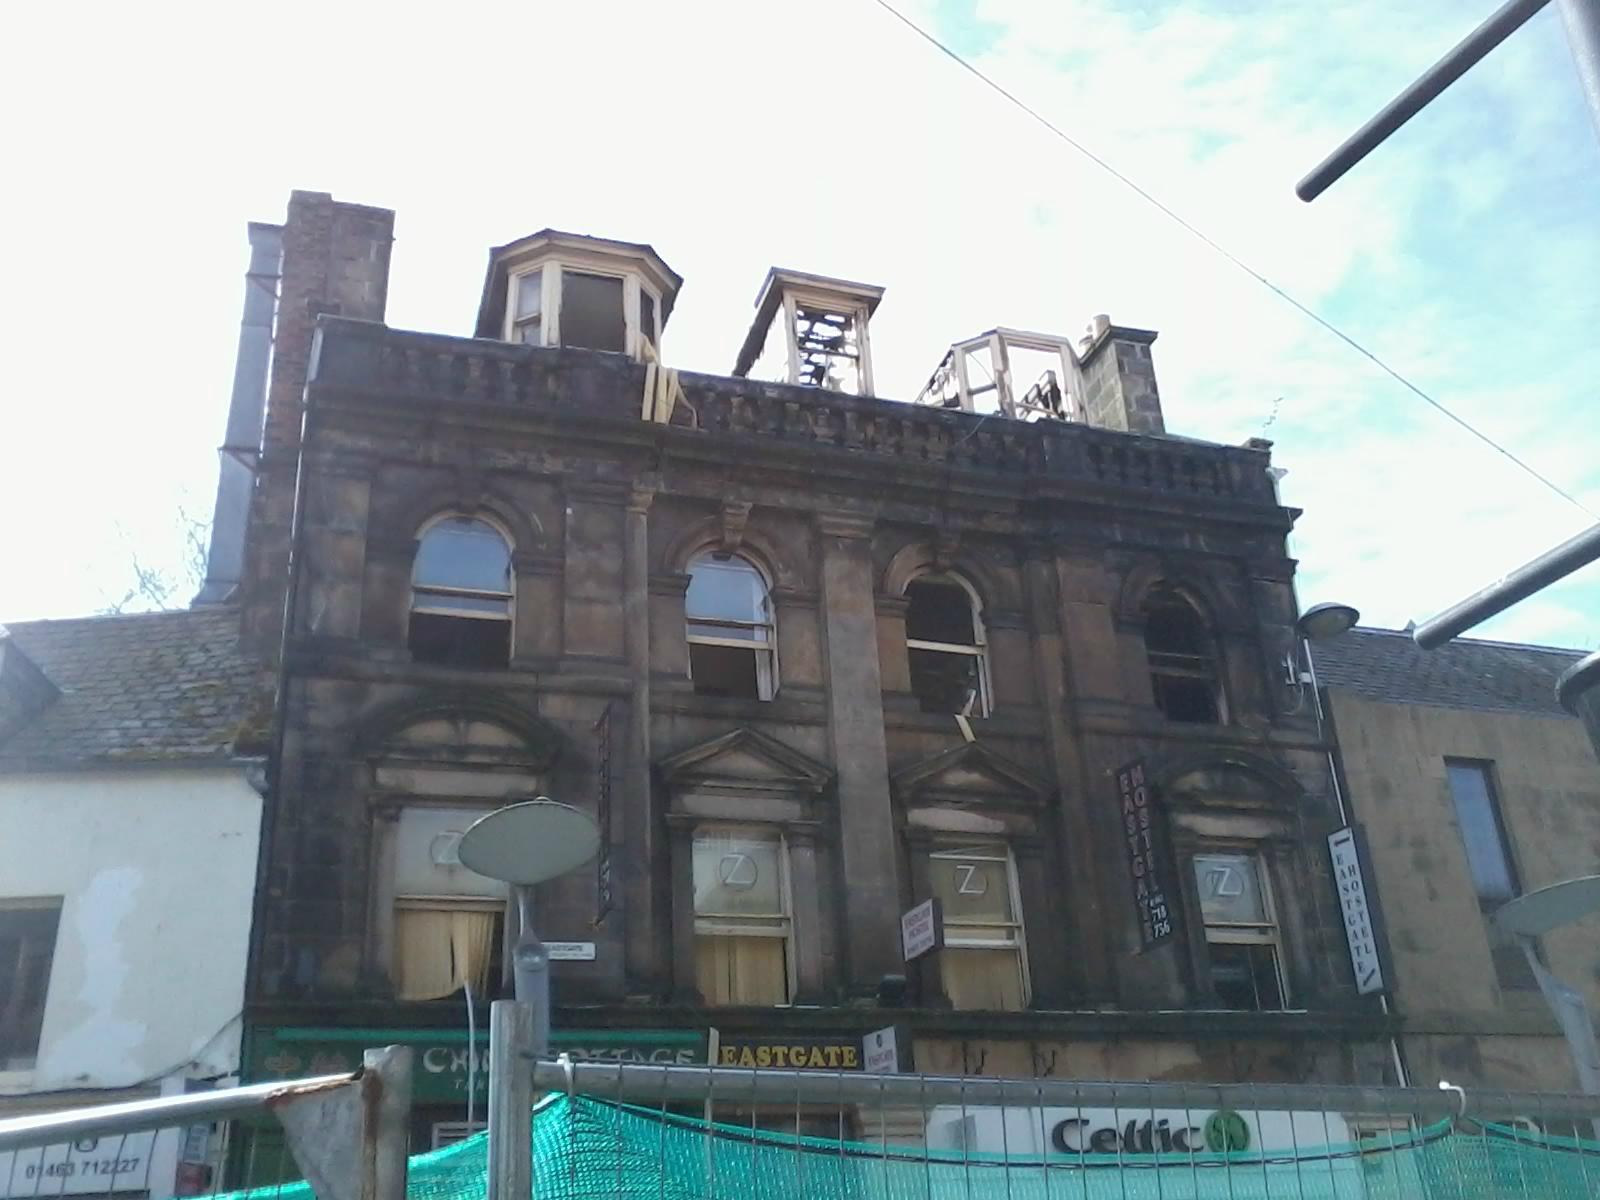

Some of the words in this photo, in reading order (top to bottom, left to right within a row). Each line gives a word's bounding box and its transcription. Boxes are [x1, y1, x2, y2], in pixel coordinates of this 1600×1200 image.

[956, 864, 985, 894] Z
[1334, 852, 1365, 974] EASTGATE
[1347, 864, 1372, 955] HOSTEL
[720, 1046, 857, 1068] EASTGATE
[1051, 1118, 1205, 1154] Celtic
